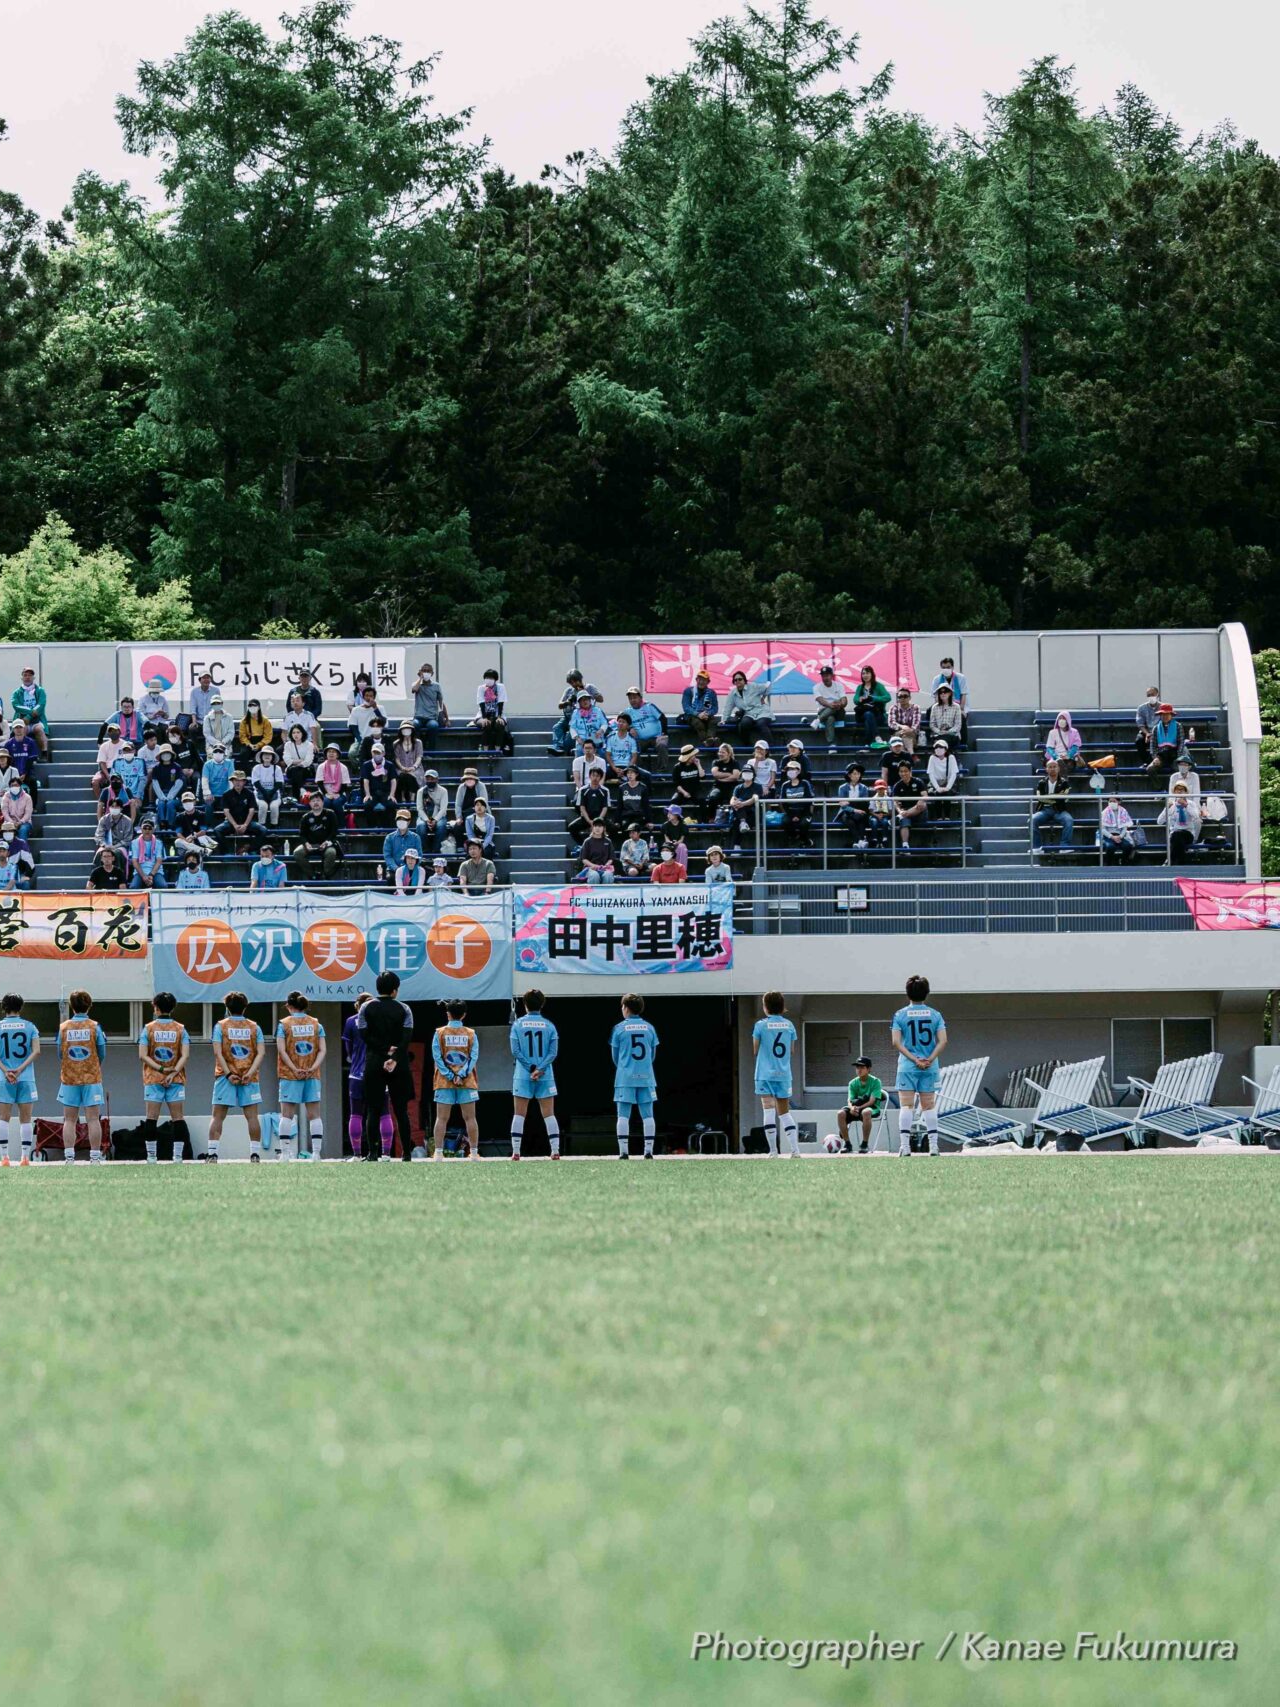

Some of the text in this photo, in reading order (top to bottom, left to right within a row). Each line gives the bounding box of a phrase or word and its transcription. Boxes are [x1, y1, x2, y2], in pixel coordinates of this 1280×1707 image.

[569, 894, 708, 908] FC FUJIZAKURA YAMANASHI
[186, 921, 486, 975] 広沢実佳子
[548, 910, 724, 962] 田中里穂
[305, 984, 366, 994] MIKAKO
[0, 1032, 28, 1059] 13
[524, 1031, 544, 1057] 11
[772, 1032, 786, 1059] 6
[907, 1019, 932, 1046] 15
[631, 1034, 646, 1061] 5
